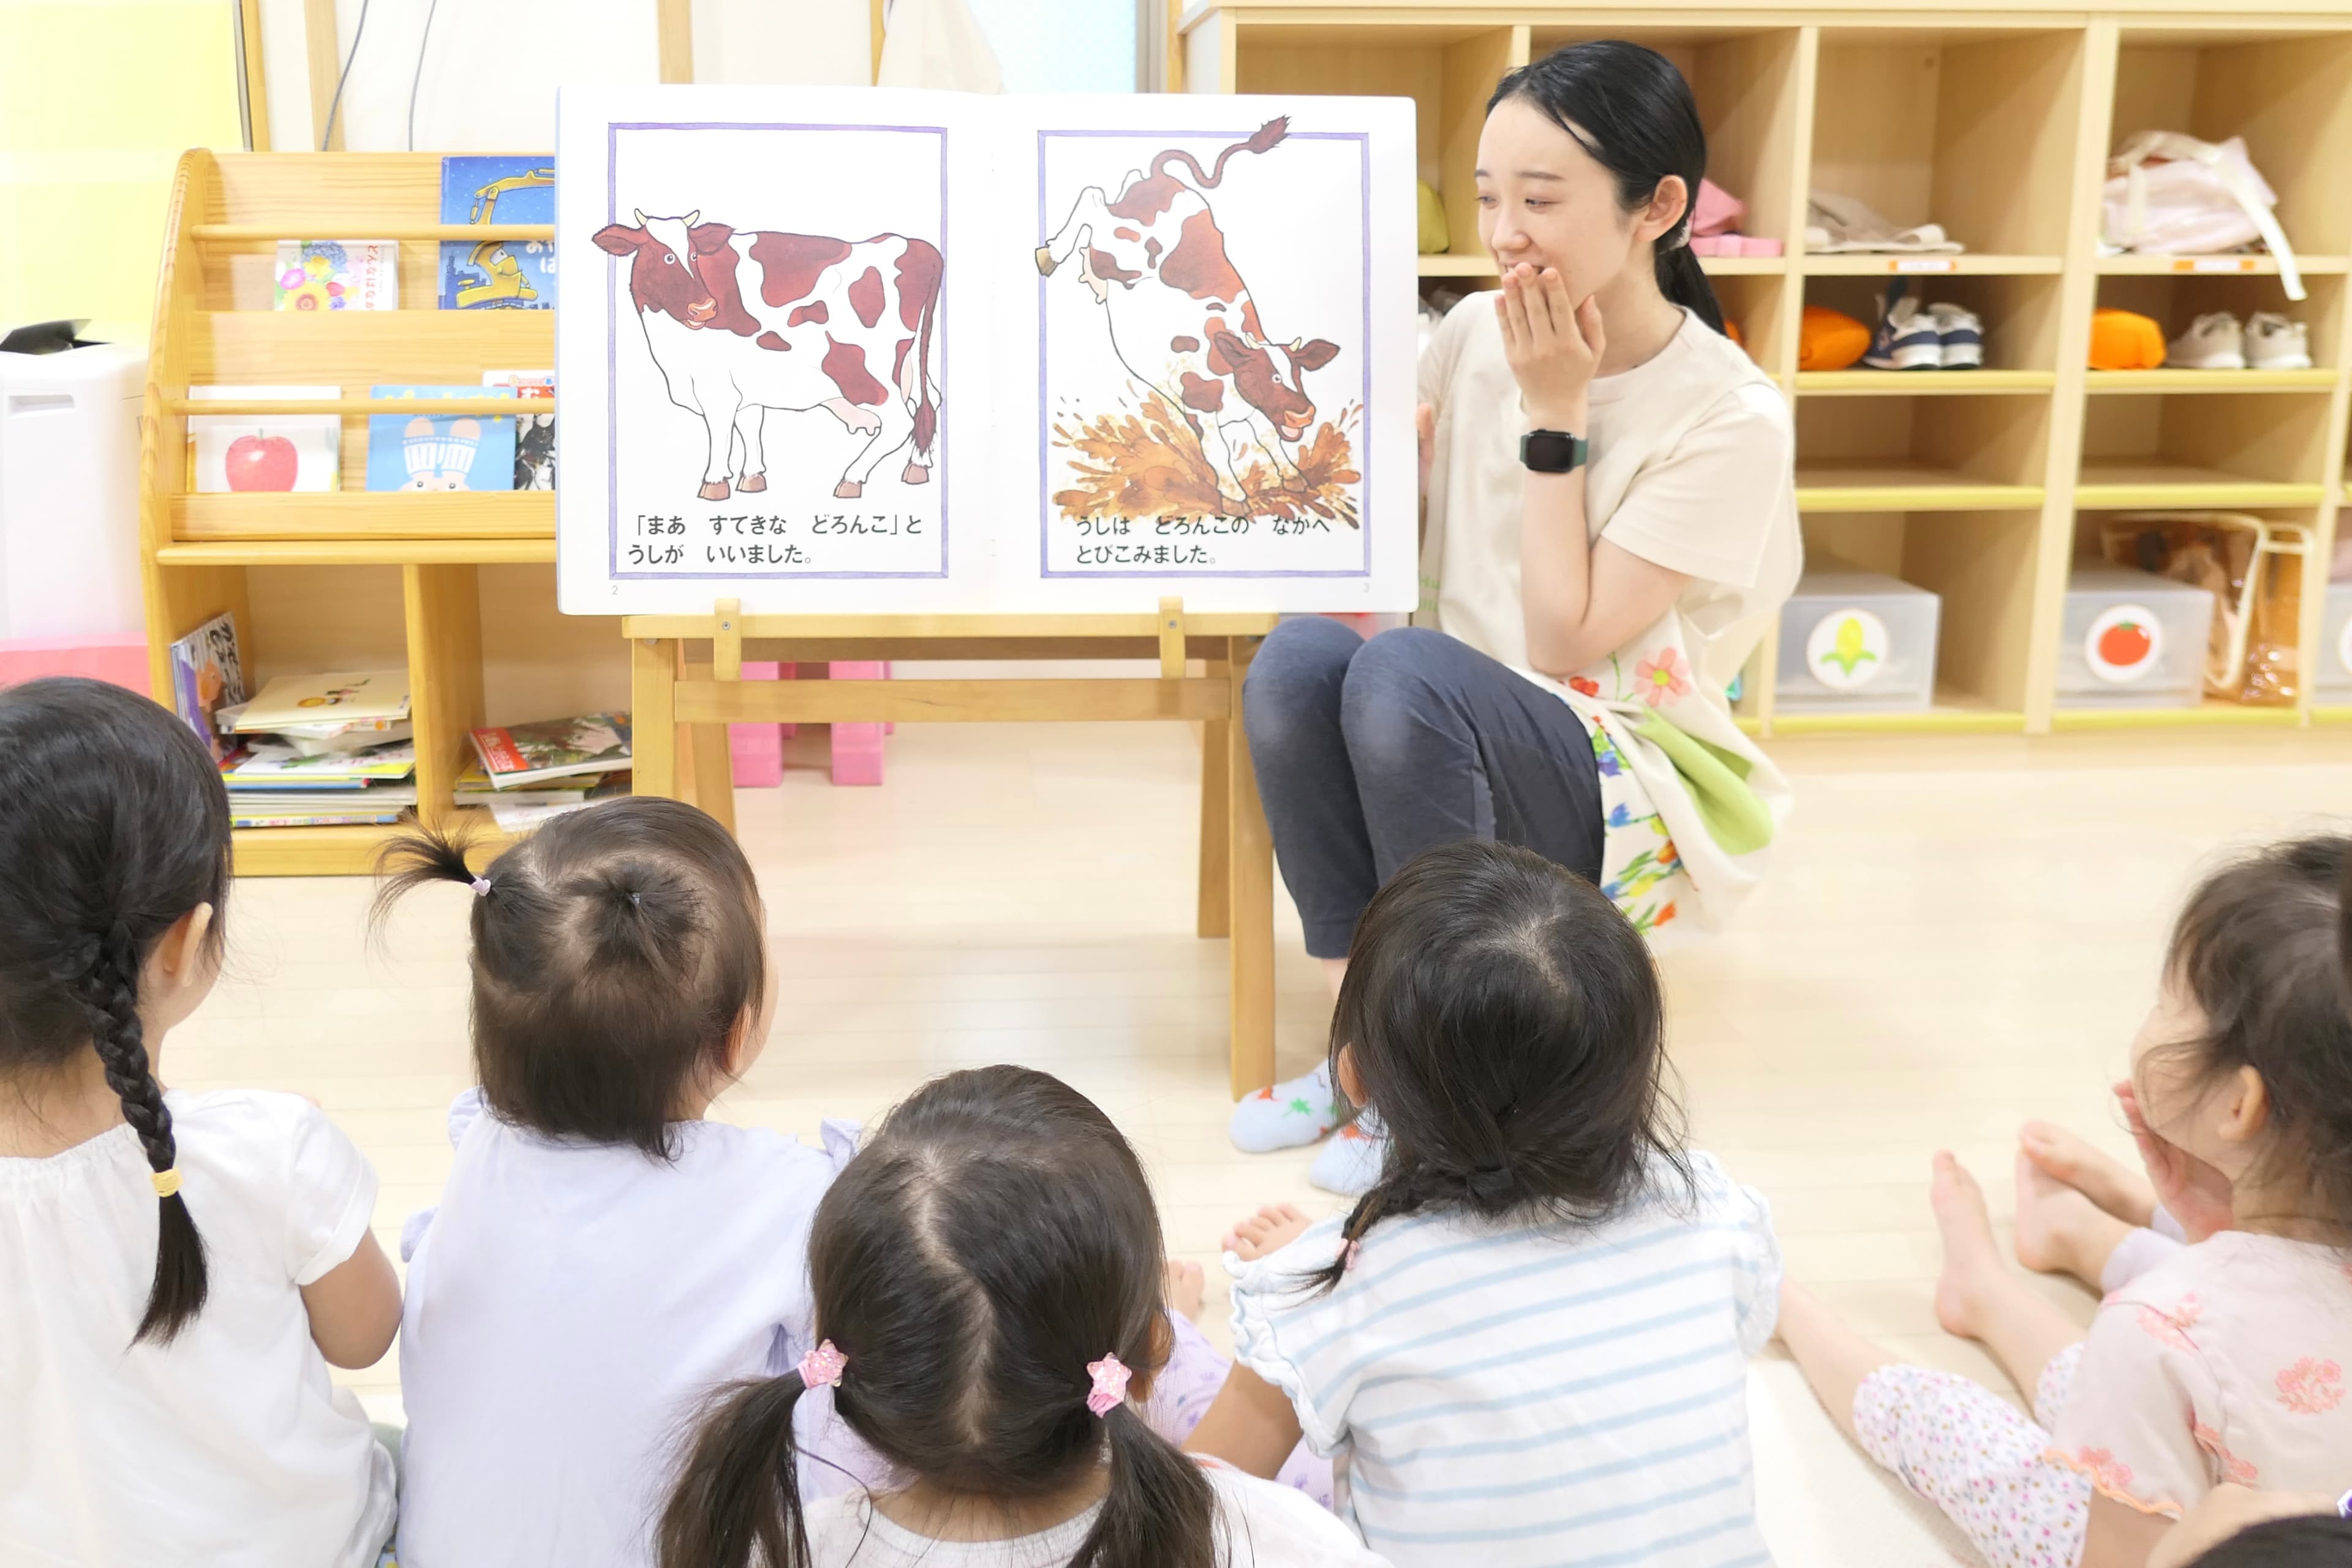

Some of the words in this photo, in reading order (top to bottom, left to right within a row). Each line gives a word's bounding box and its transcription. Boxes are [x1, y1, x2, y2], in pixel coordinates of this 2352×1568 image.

[638, 514, 687, 536] 「まあ
[709, 515, 787, 535] すてきな
[812, 514, 922, 535] どろんこ」と
[1076, 516, 1130, 536] うしは
[1155, 516, 1249, 535] どろんこの
[1273, 516, 1330, 535] なかへ
[628, 544, 685, 565] うしが
[706, 544, 812, 564] いいました。
[1076, 544, 1216, 564] とびこみました。
[611, 585, 619, 595] 2
[1363, 582, 1371, 593] 3
